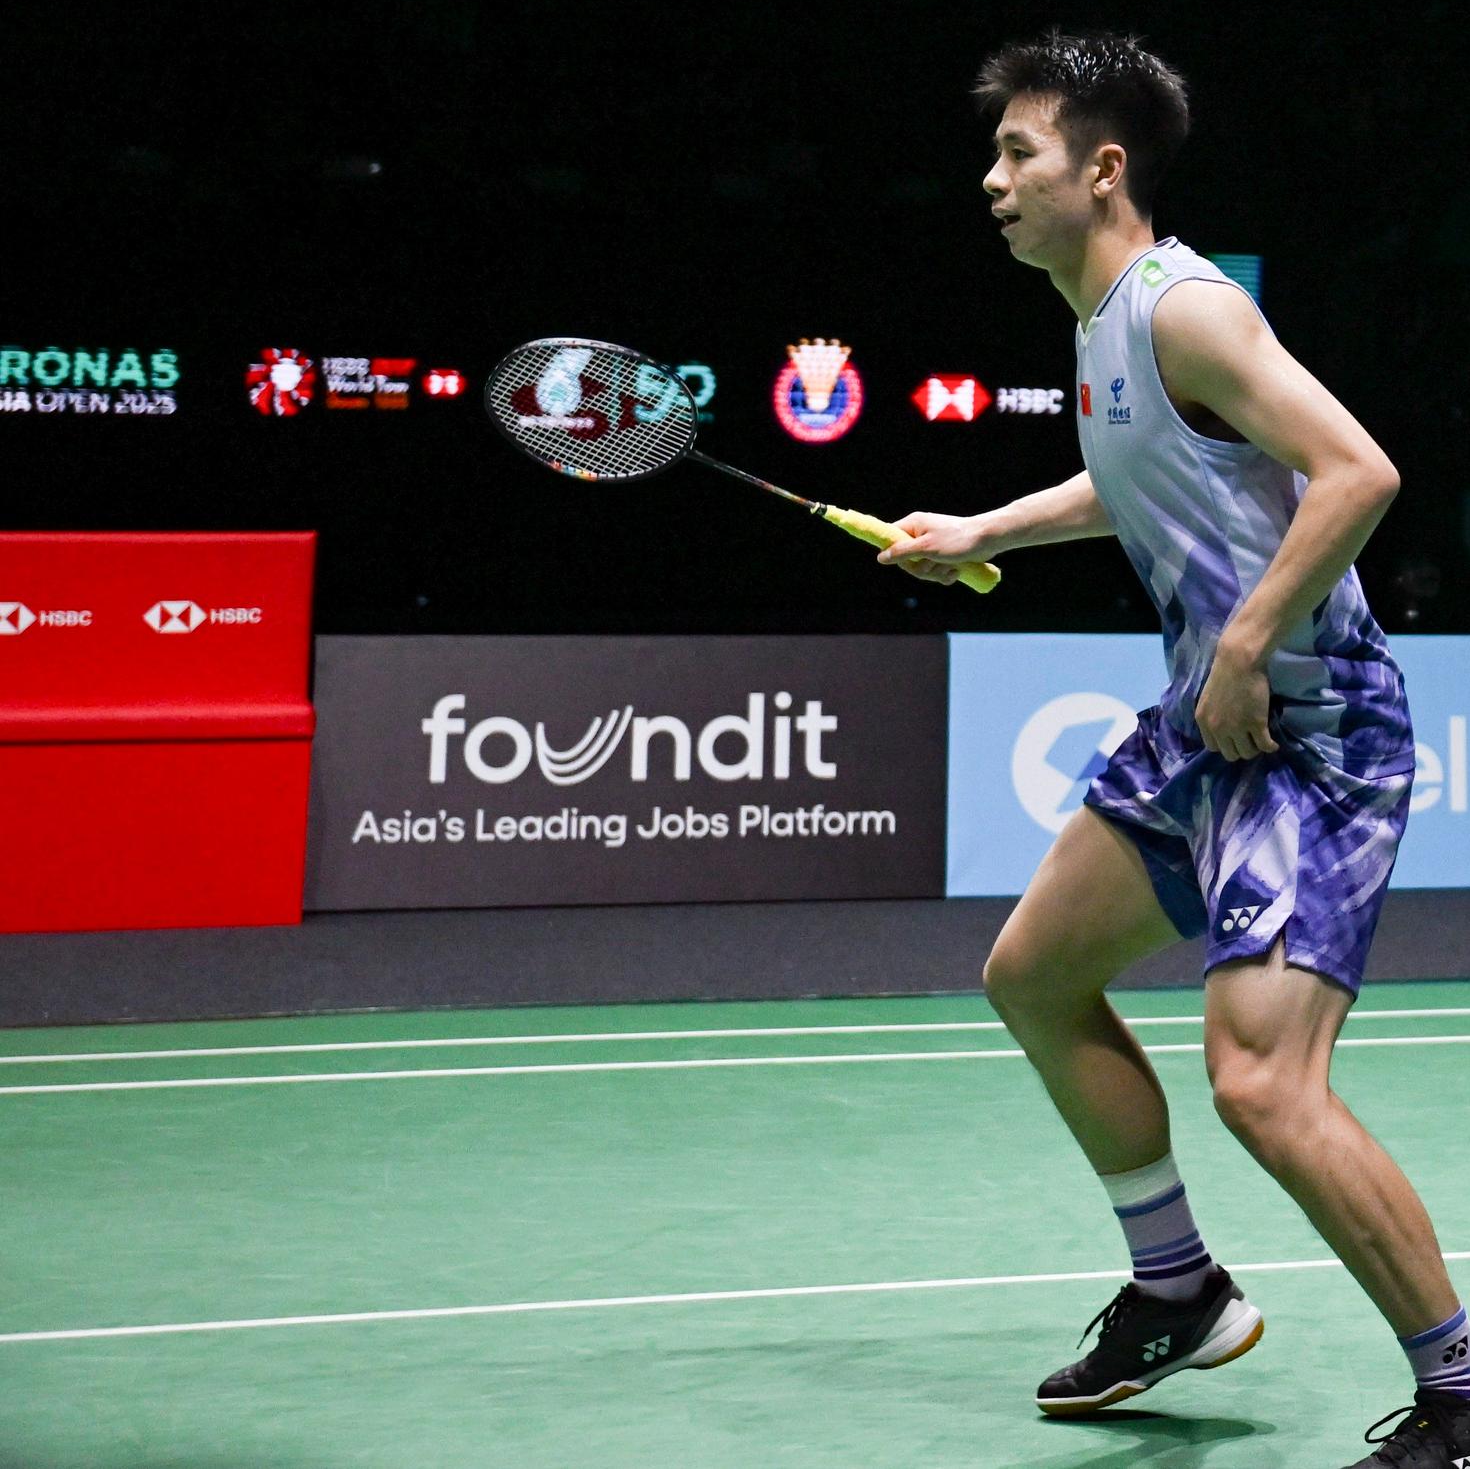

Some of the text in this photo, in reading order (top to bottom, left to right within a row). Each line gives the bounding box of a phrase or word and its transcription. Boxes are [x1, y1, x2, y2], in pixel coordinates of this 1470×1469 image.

[39, 610, 93, 627] HSBC
[210, 608, 262, 625] HSBC
[422, 692, 838, 785] foundit
[353, 804, 896, 848] Asia's Leading Jobs Platform
